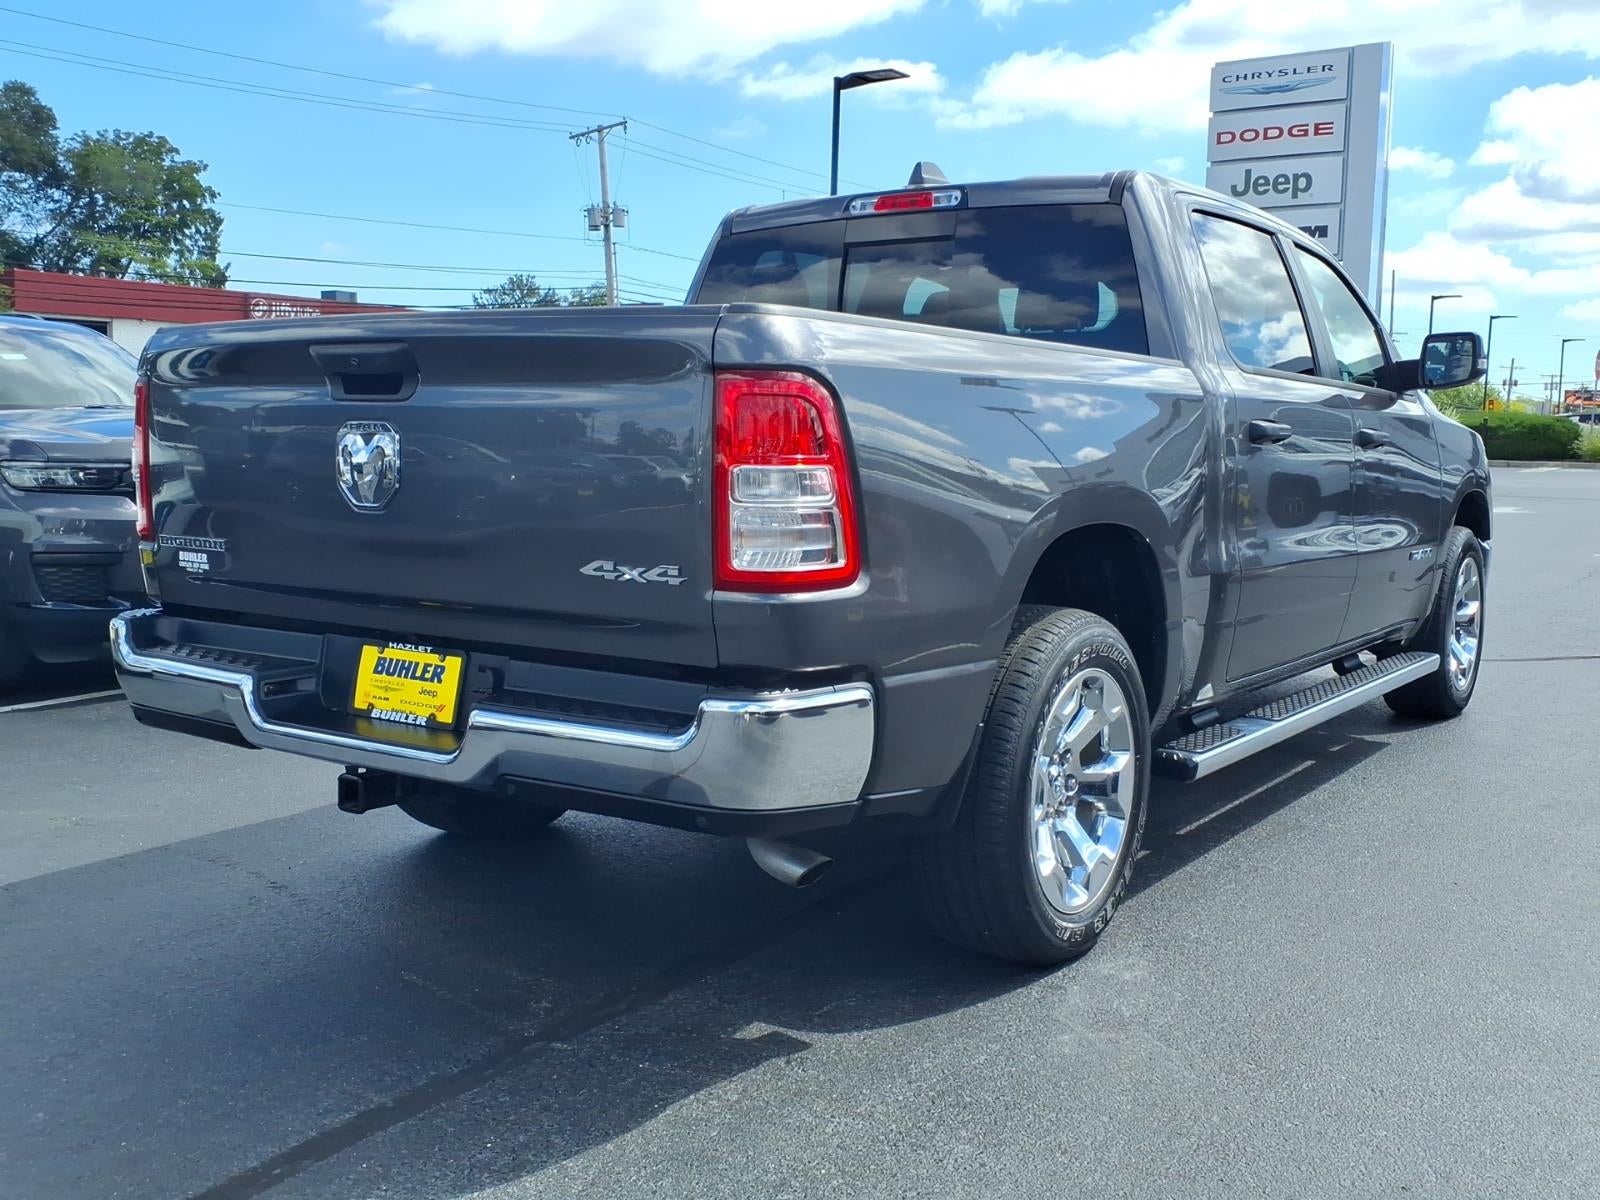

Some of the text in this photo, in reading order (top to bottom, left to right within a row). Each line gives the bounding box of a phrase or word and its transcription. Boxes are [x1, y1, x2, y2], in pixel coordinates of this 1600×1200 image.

[1222, 64, 1334, 83] CHRYSLER
[1216, 121, 1334, 145] DODGE
[1230, 168, 1313, 199] Jeep
[178, 551, 208, 563] BUHLER
[388, 642, 433, 653] HAZLET
[373, 656, 446, 684] BUHLER
[418, 687, 438, 699] Jeep
[400, 699, 439, 709] DODGE
[370, 708, 428, 726] BUHLER
